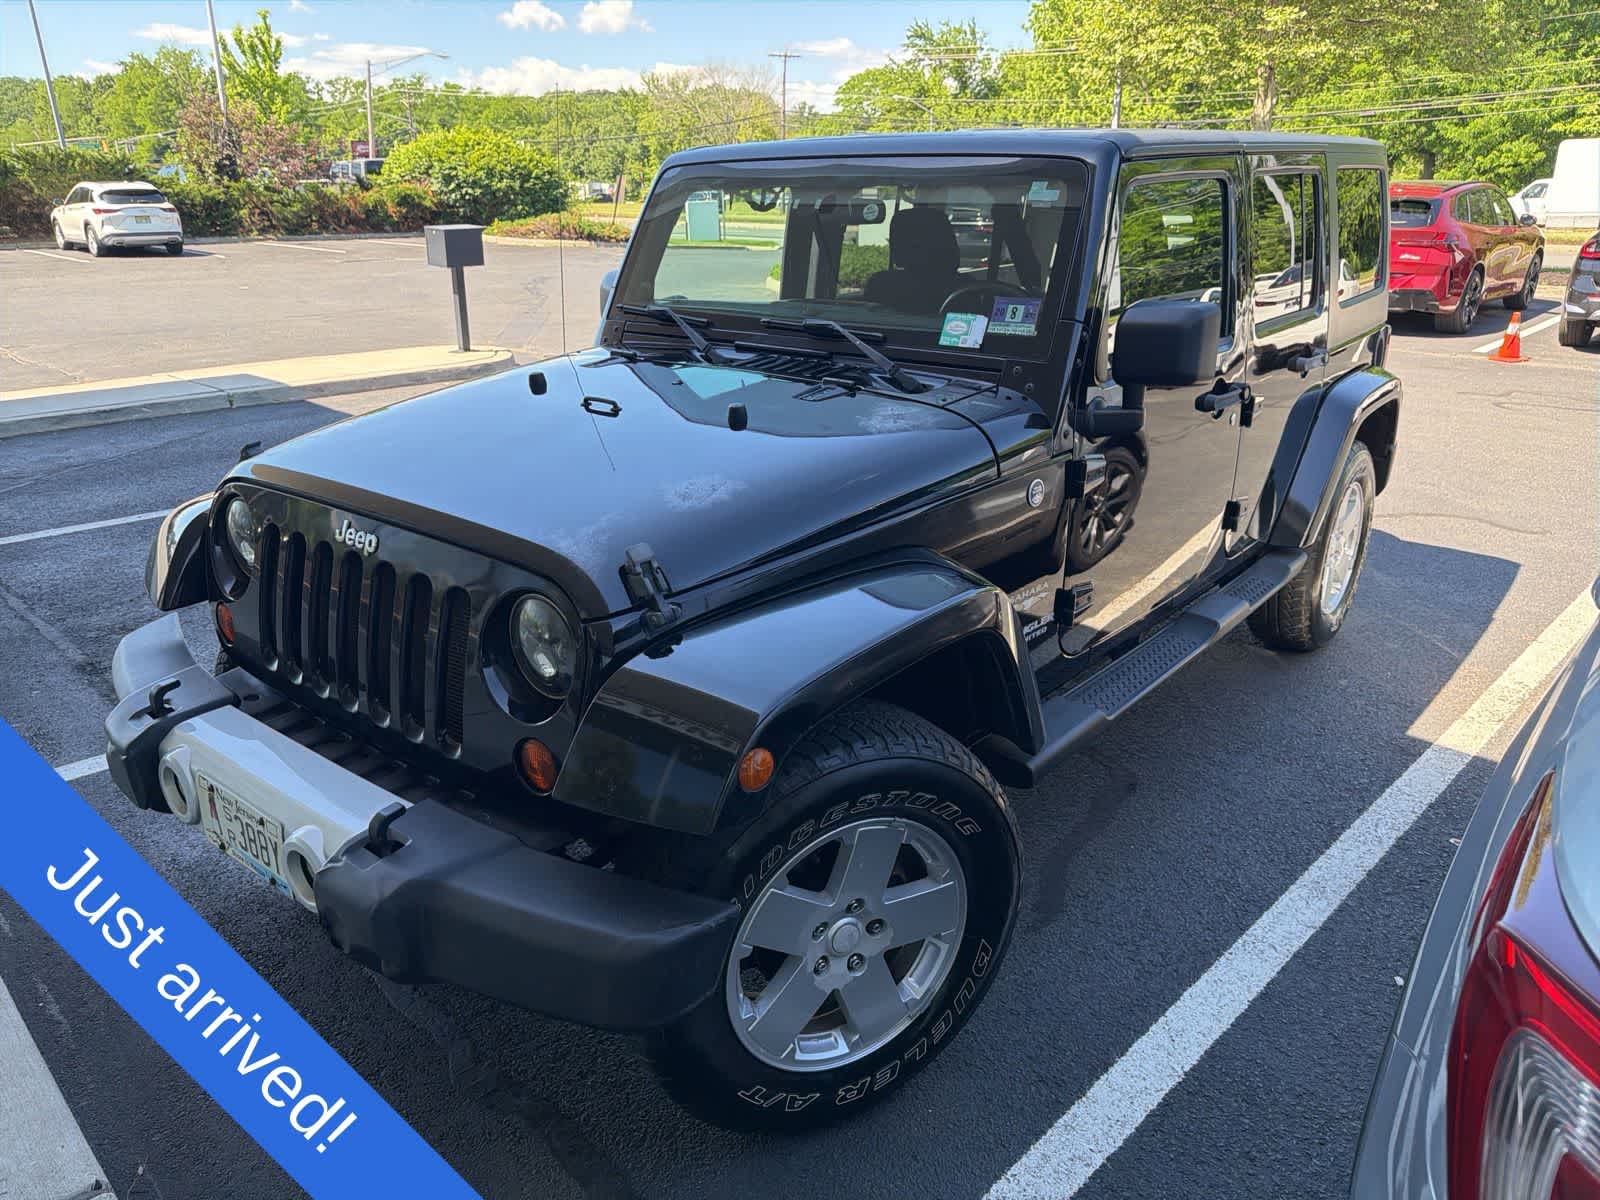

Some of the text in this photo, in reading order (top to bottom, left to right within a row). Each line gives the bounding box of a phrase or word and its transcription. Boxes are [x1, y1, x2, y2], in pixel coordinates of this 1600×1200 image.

[335, 519, 378, 557] Jeep
[730, 790, 983, 912] IDGESTONE
[835, 938, 993, 1106] DUELER
